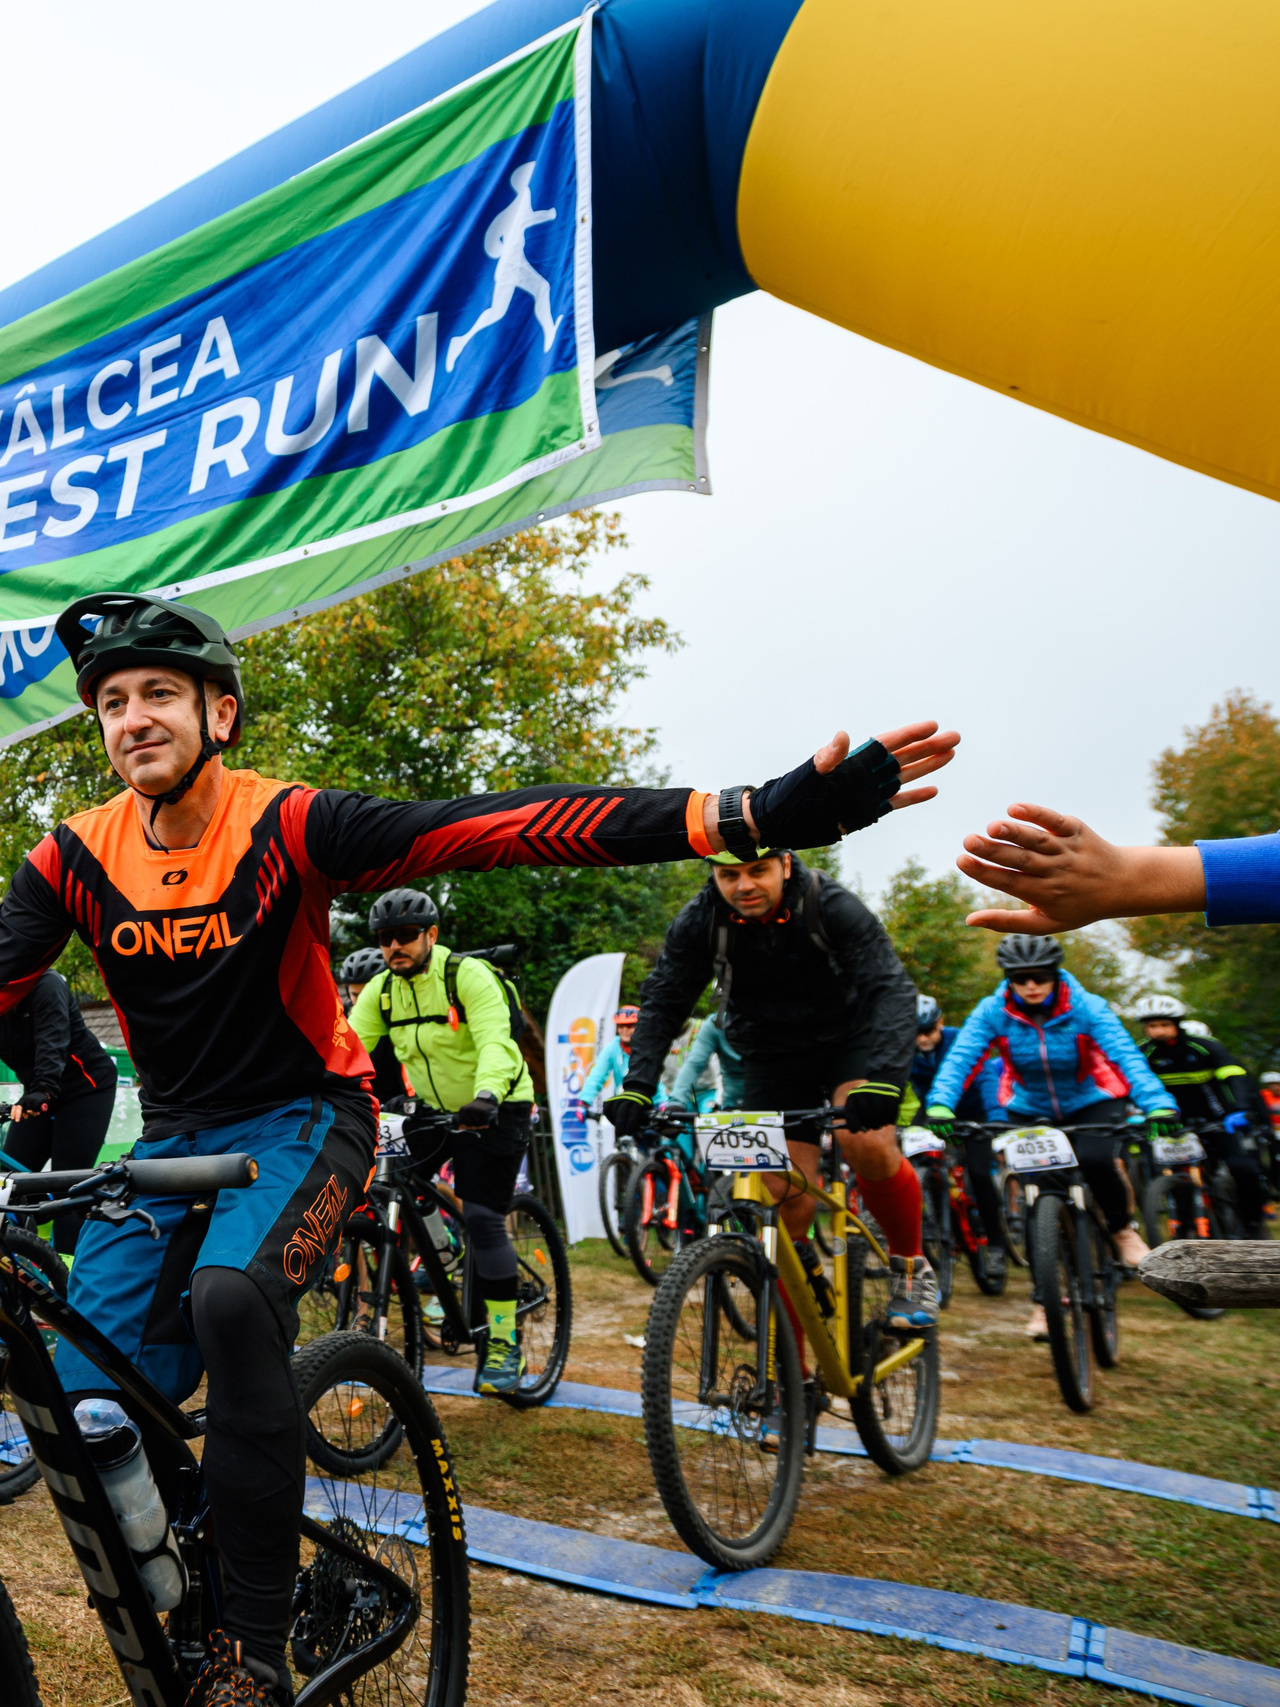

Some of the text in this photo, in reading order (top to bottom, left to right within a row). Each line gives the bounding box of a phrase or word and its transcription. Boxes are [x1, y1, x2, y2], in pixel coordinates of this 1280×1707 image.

[189, 311, 438, 495] RUN
[713, 1130, 769, 1149] 4050
[1017, 1139, 1058, 1156] 4033
[430, 1438, 463, 1541] MAXXIS
